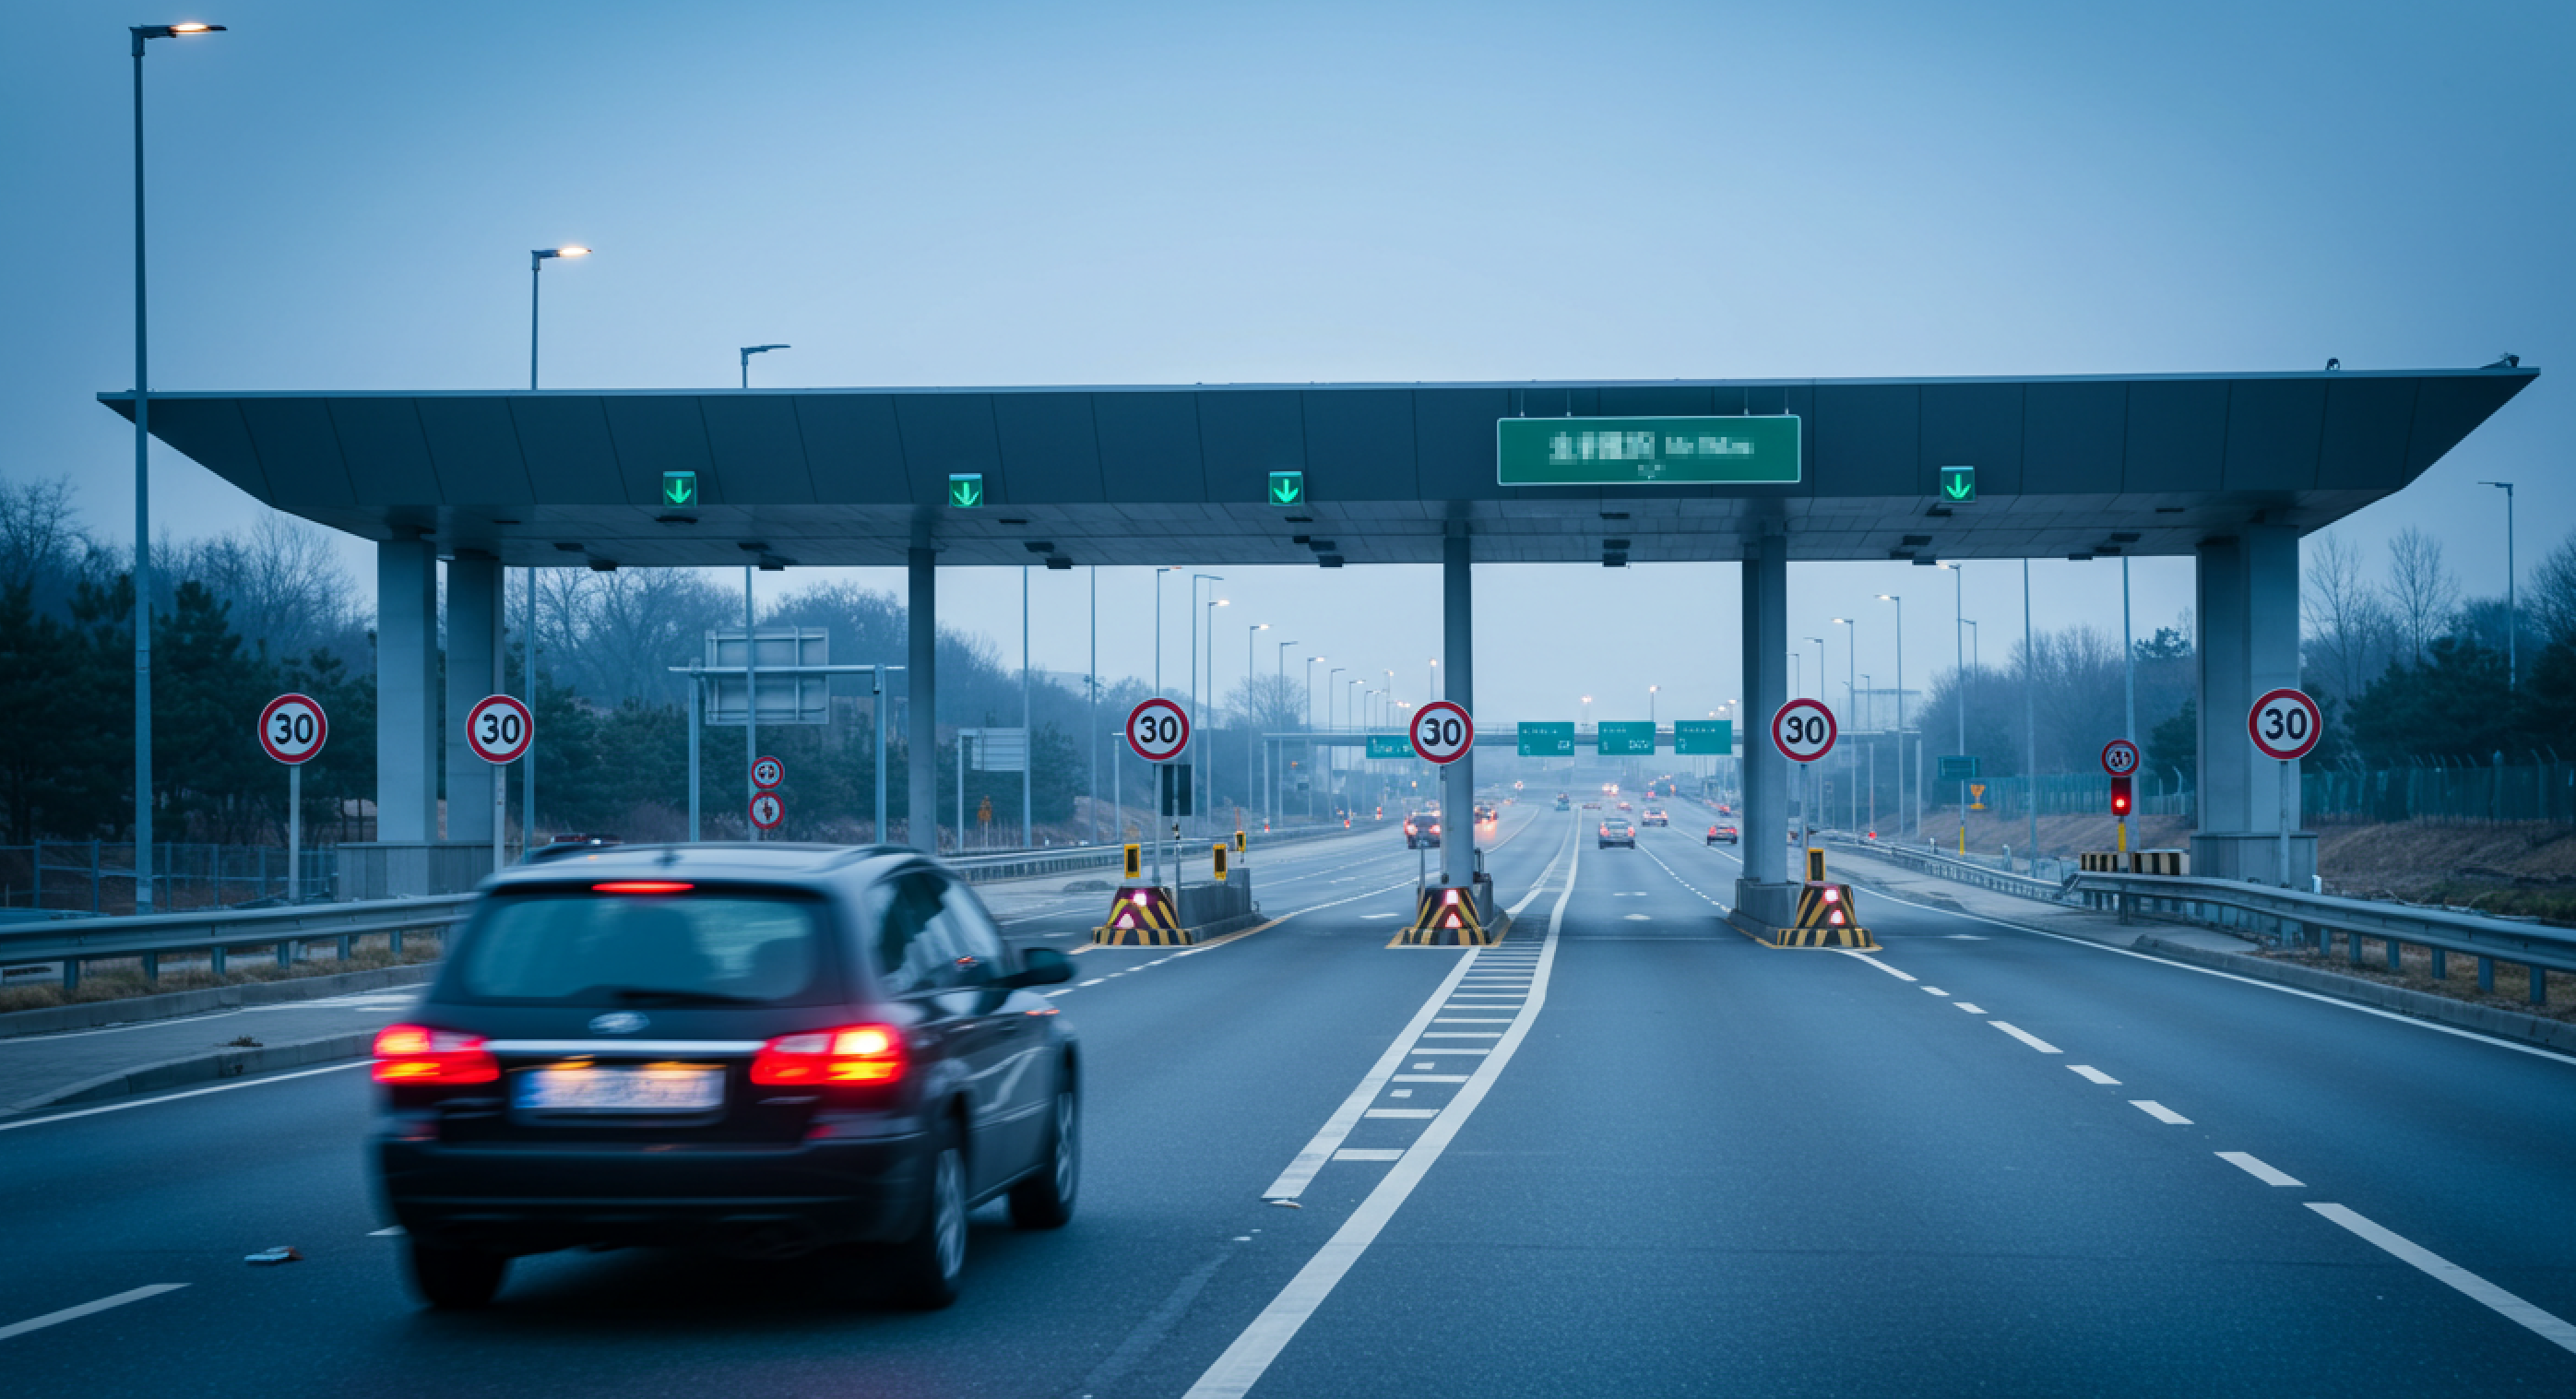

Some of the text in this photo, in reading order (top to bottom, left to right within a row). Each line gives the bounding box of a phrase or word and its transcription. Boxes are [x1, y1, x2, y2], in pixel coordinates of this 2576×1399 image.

[275, 712, 314, 745] 30
[481, 714, 520, 744] 30
[1140, 716, 1179, 743] 30
[1423, 717, 1461, 747] 30
[2265, 707, 2308, 741] 30
